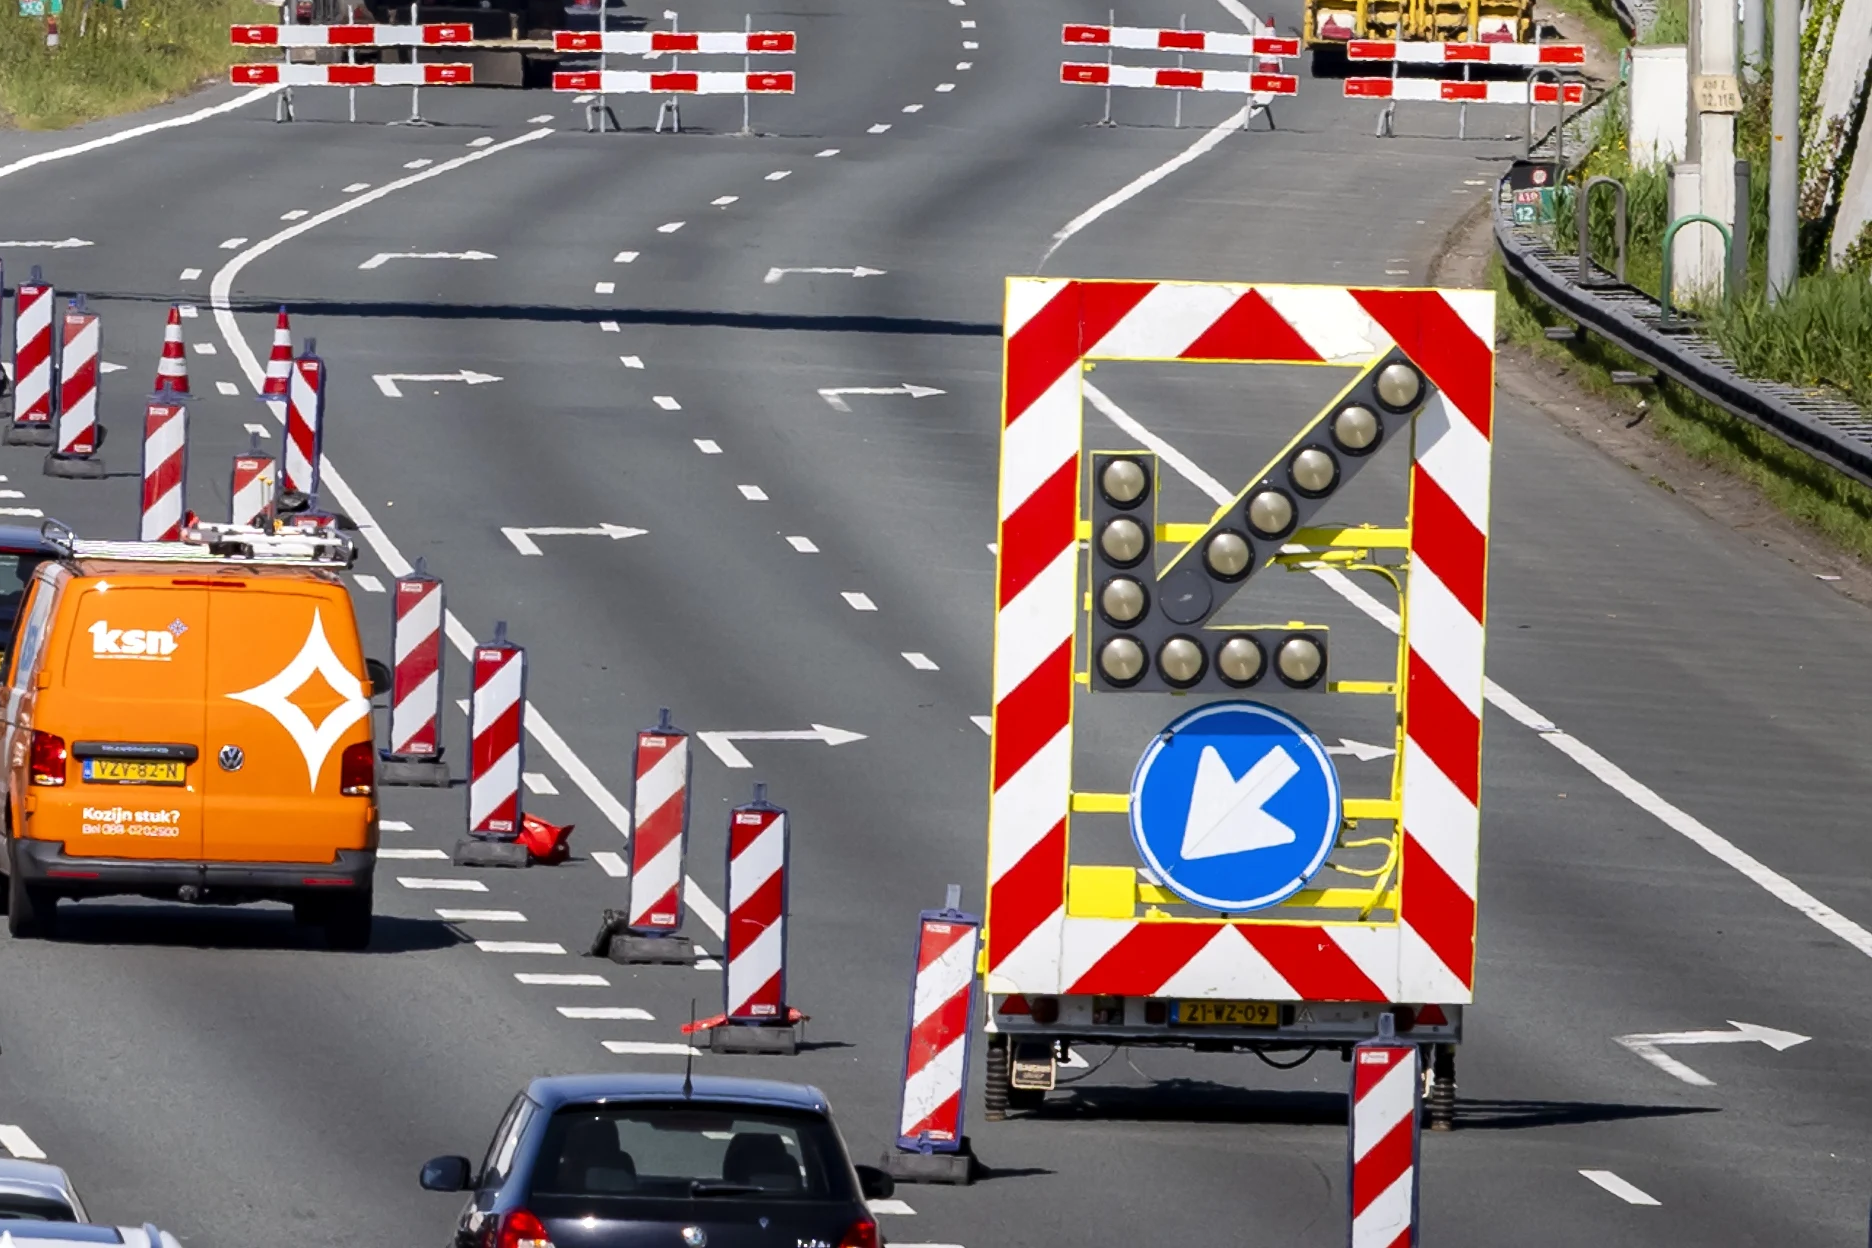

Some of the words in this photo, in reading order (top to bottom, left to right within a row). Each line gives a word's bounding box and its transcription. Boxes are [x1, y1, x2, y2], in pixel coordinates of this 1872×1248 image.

[88, 620, 179, 656] ksn
[82, 806, 132, 824] Kozijn
[134, 809, 180, 824] stuk?
